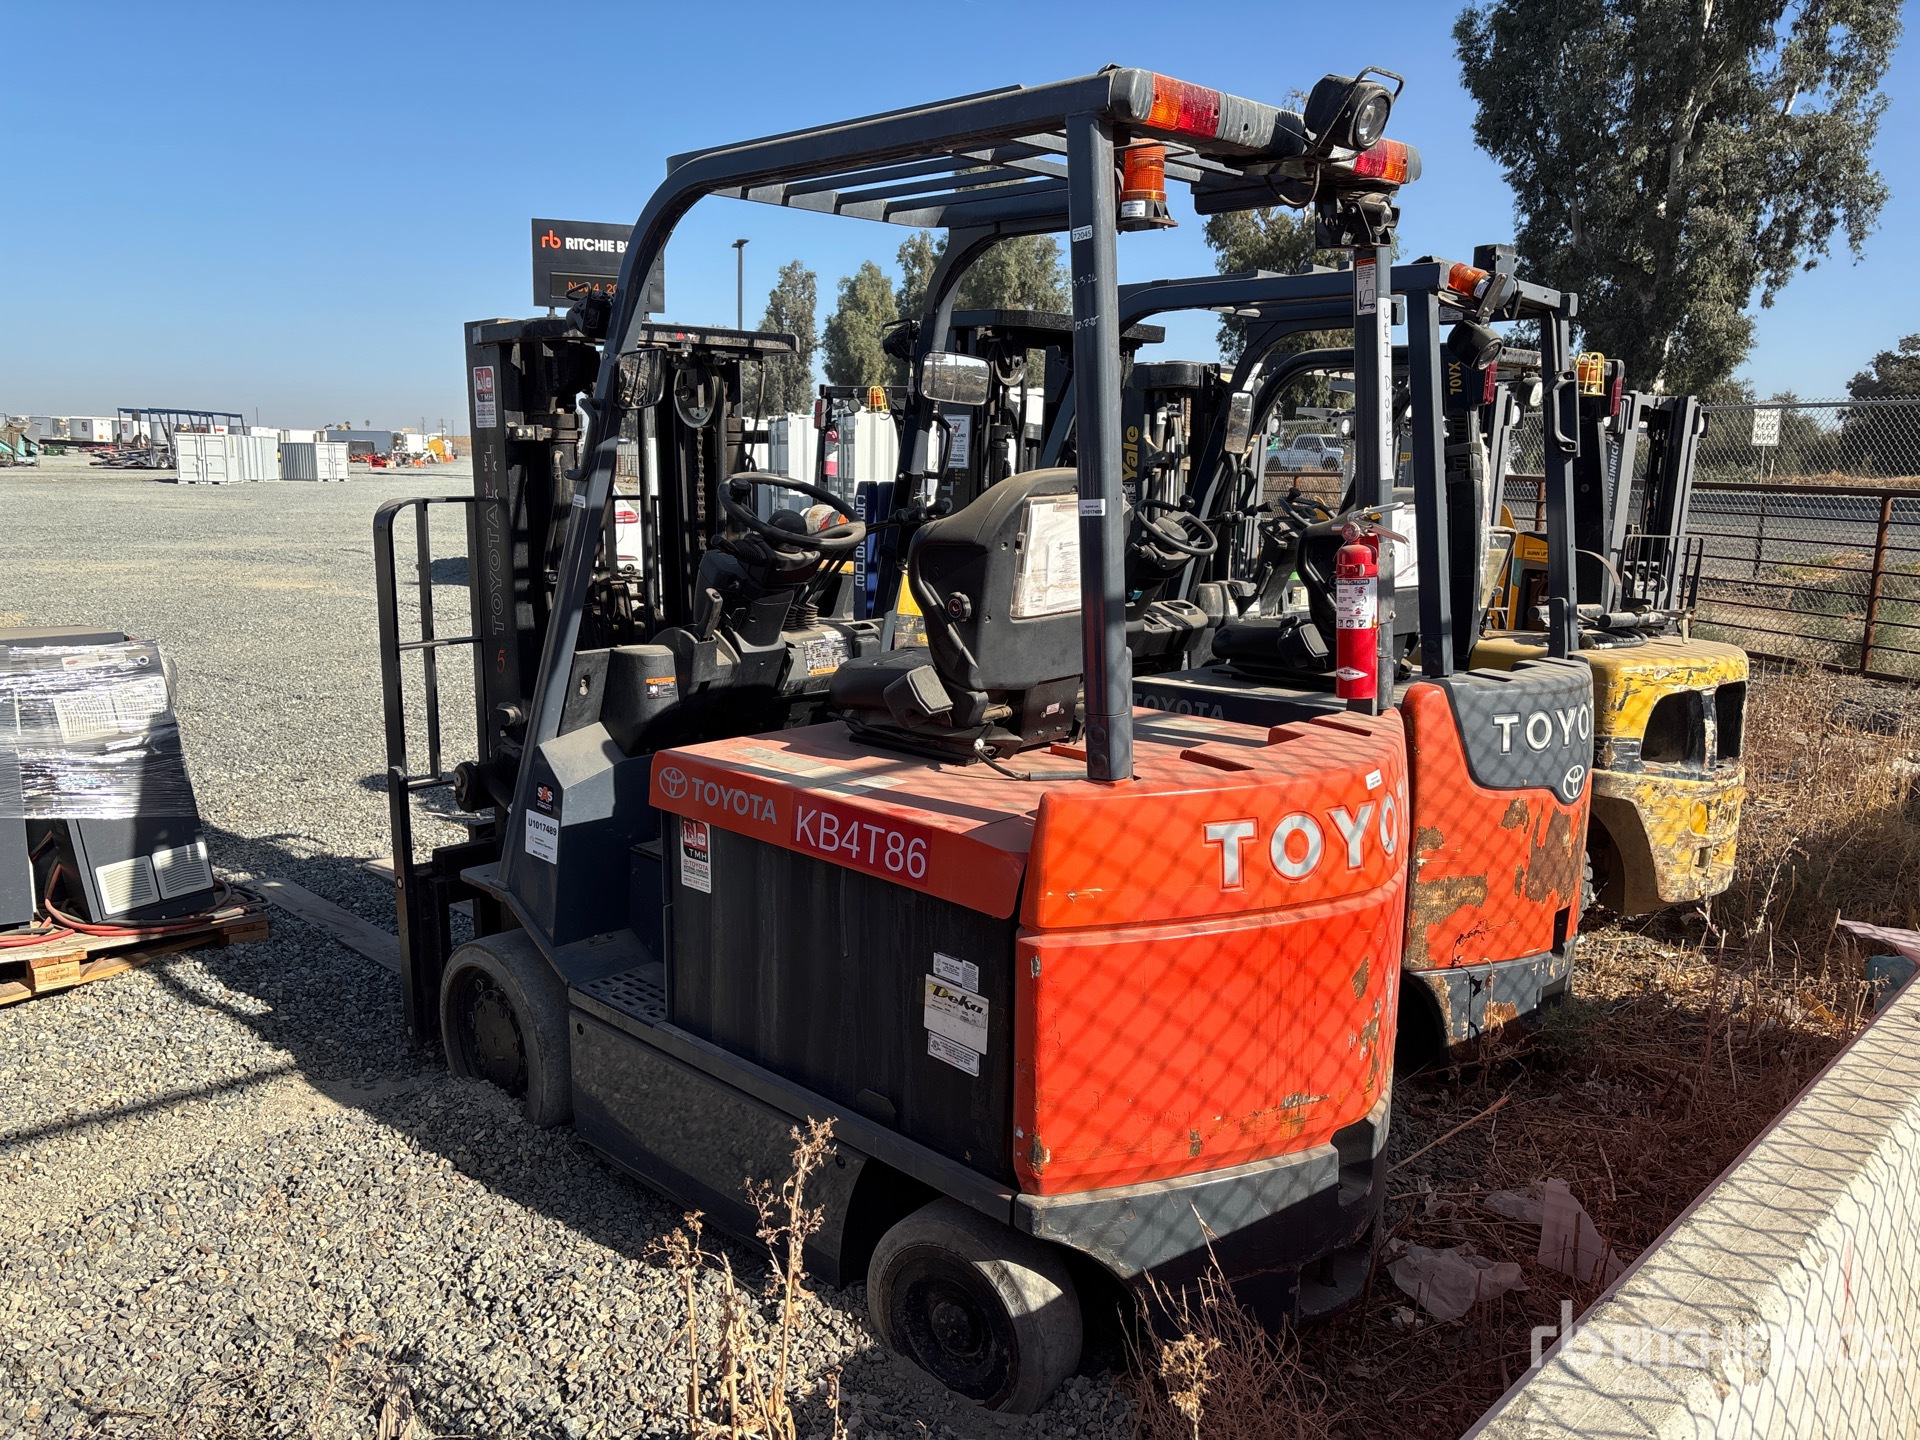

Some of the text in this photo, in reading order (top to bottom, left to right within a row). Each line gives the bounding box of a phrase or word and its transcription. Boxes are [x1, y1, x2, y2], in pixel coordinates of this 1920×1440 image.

[541, 229, 562, 249] rb
[565, 237, 615, 252] RITCHIE
[1448, 361, 1463, 395] 70VX
[1755, 433, 1776, 441] RIGHT
[1756, 422, 1776, 430] KEEP
[1122, 425, 1139, 480] Yale
[1608, 441, 1620, 511] NGHEINRICH
[486, 503, 504, 636] TOYOTA
[497, 650, 505, 673] 5
[1133, 693, 1224, 719] TOYOTA
[1493, 702, 1589, 755] TOYO
[537, 786, 553, 802] SAS
[691, 777, 777, 825] TOYOTA
[528, 818, 557, 836] U1017489
[688, 848, 707, 861] TMH
[796, 805, 927, 879] KB4T86
[689, 862, 709, 872] TOYOTA
[930, 984, 983, 1014] Deka
